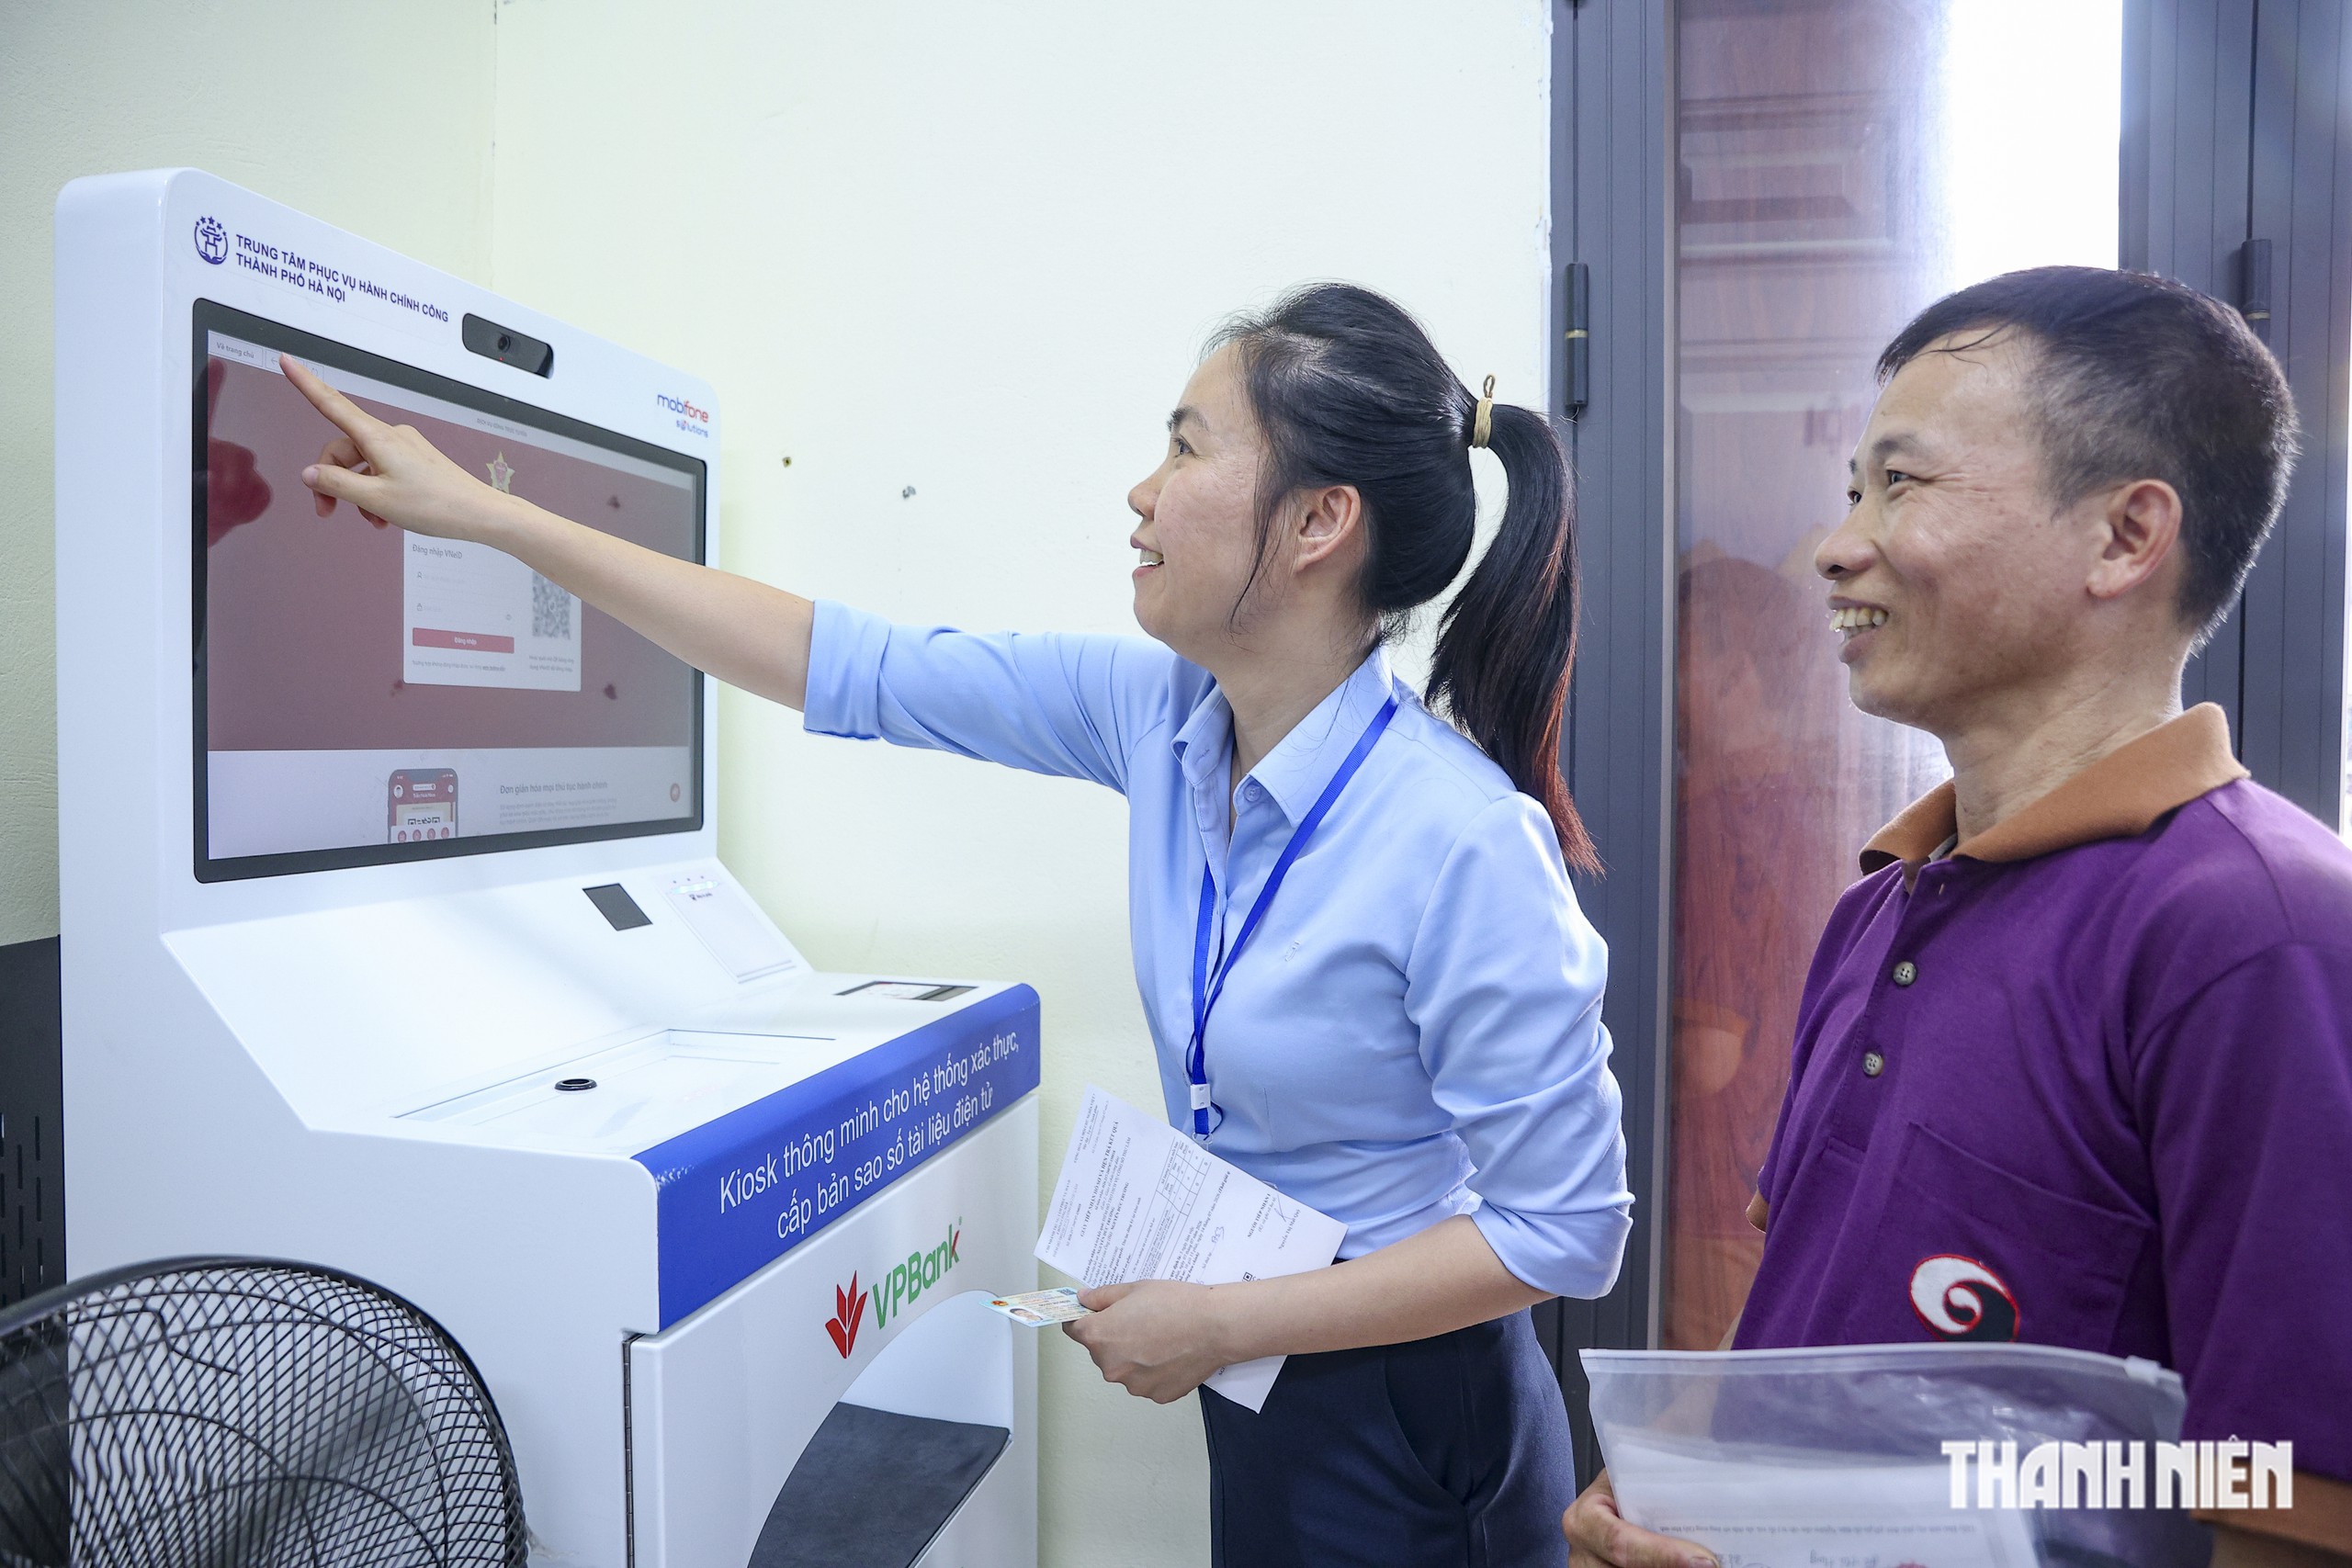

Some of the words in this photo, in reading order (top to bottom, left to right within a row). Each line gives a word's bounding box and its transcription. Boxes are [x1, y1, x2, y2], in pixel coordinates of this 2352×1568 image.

[236, 252, 277, 278] THÀNH
[280, 265, 305, 288] PHỐ
[309, 278, 324, 295] HÀ
[326, 287, 345, 302] NỘI
[236, 234, 277, 260] TRUNG
[282, 251, 306, 271] TÂM
[309, 261, 339, 283] PHỤC
[342, 273, 356, 289] VỤ
[359, 276, 388, 301] HÀNH
[390, 292, 419, 312] CHÍNH
[422, 301, 448, 322] CÔNG
[226, 344, 242, 357] trang
[243, 349, 254, 358] chủ
[657, 394, 708, 423] mobifone
[413, 544, 427, 556] Đăng
[429, 547, 444, 558] nhập
[444, 549, 463, 559] VNeID
[500, 785, 514, 794] Đơn
[514, 784, 529, 795] giản
[719, 1152, 778, 1214] Kiosk
[783, 1126, 835, 1178] thông
[841, 1100, 879, 1148] minh
[883, 1090, 910, 1122] cho
[913, 1073, 931, 1106] hệ
[933, 1052, 968, 1095] thống
[971, 1043, 991, 1074] xác
[992, 1029, 1019, 1062] thực,
[778, 1190, 812, 1239] cấp
[817, 1171, 849, 1214] bản
[854, 1155, 882, 1191] sao
[887, 1128, 904, 1171] số
[908, 1128, 924, 1158] tài
[928, 1109, 950, 1147] liệu
[954, 1092, 979, 1129] điện
[981, 1081, 993, 1109] tử
[873, 1224, 960, 1330] VPBank
